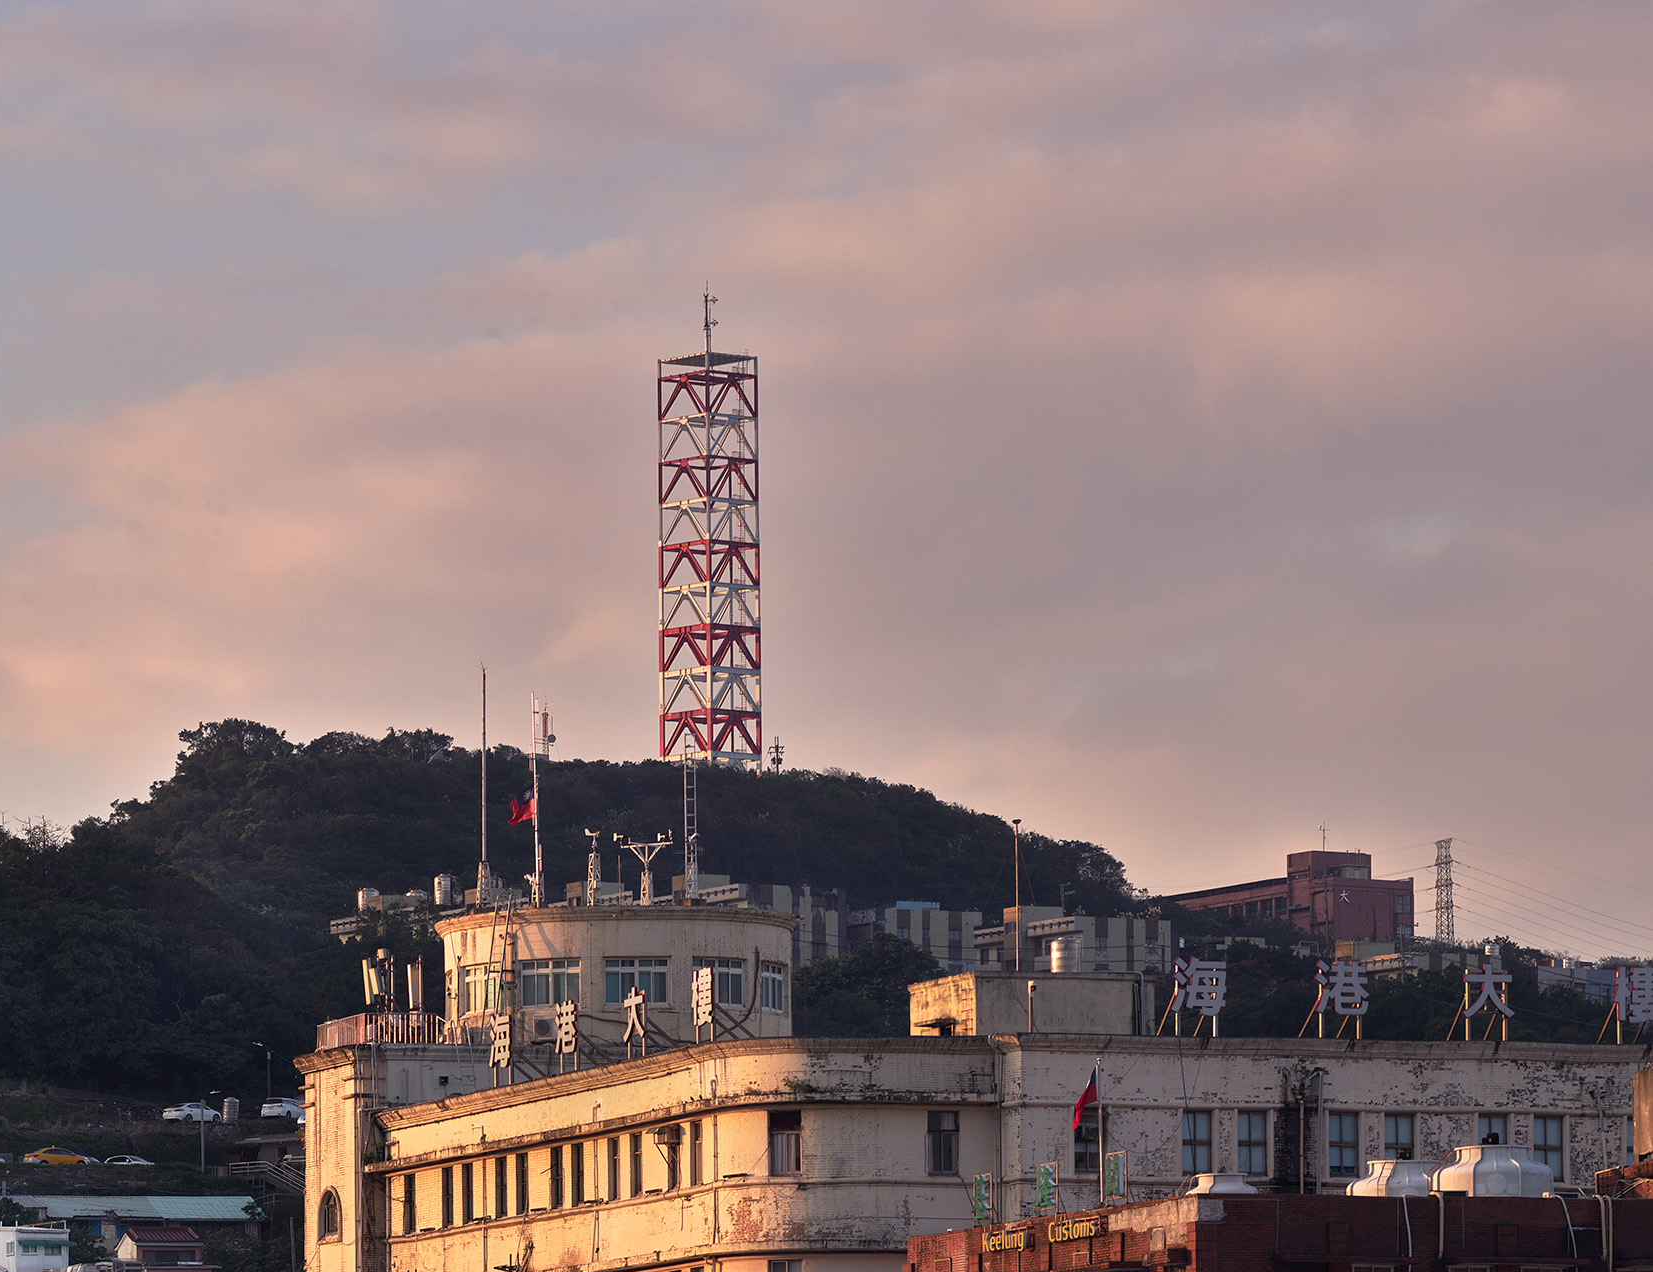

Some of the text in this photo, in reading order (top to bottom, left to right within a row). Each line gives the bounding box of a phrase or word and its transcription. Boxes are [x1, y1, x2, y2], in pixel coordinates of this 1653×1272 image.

[489, 967, 714, 1069] 海港大樓
[981, 1219, 1098, 1252] Keelung Customs
